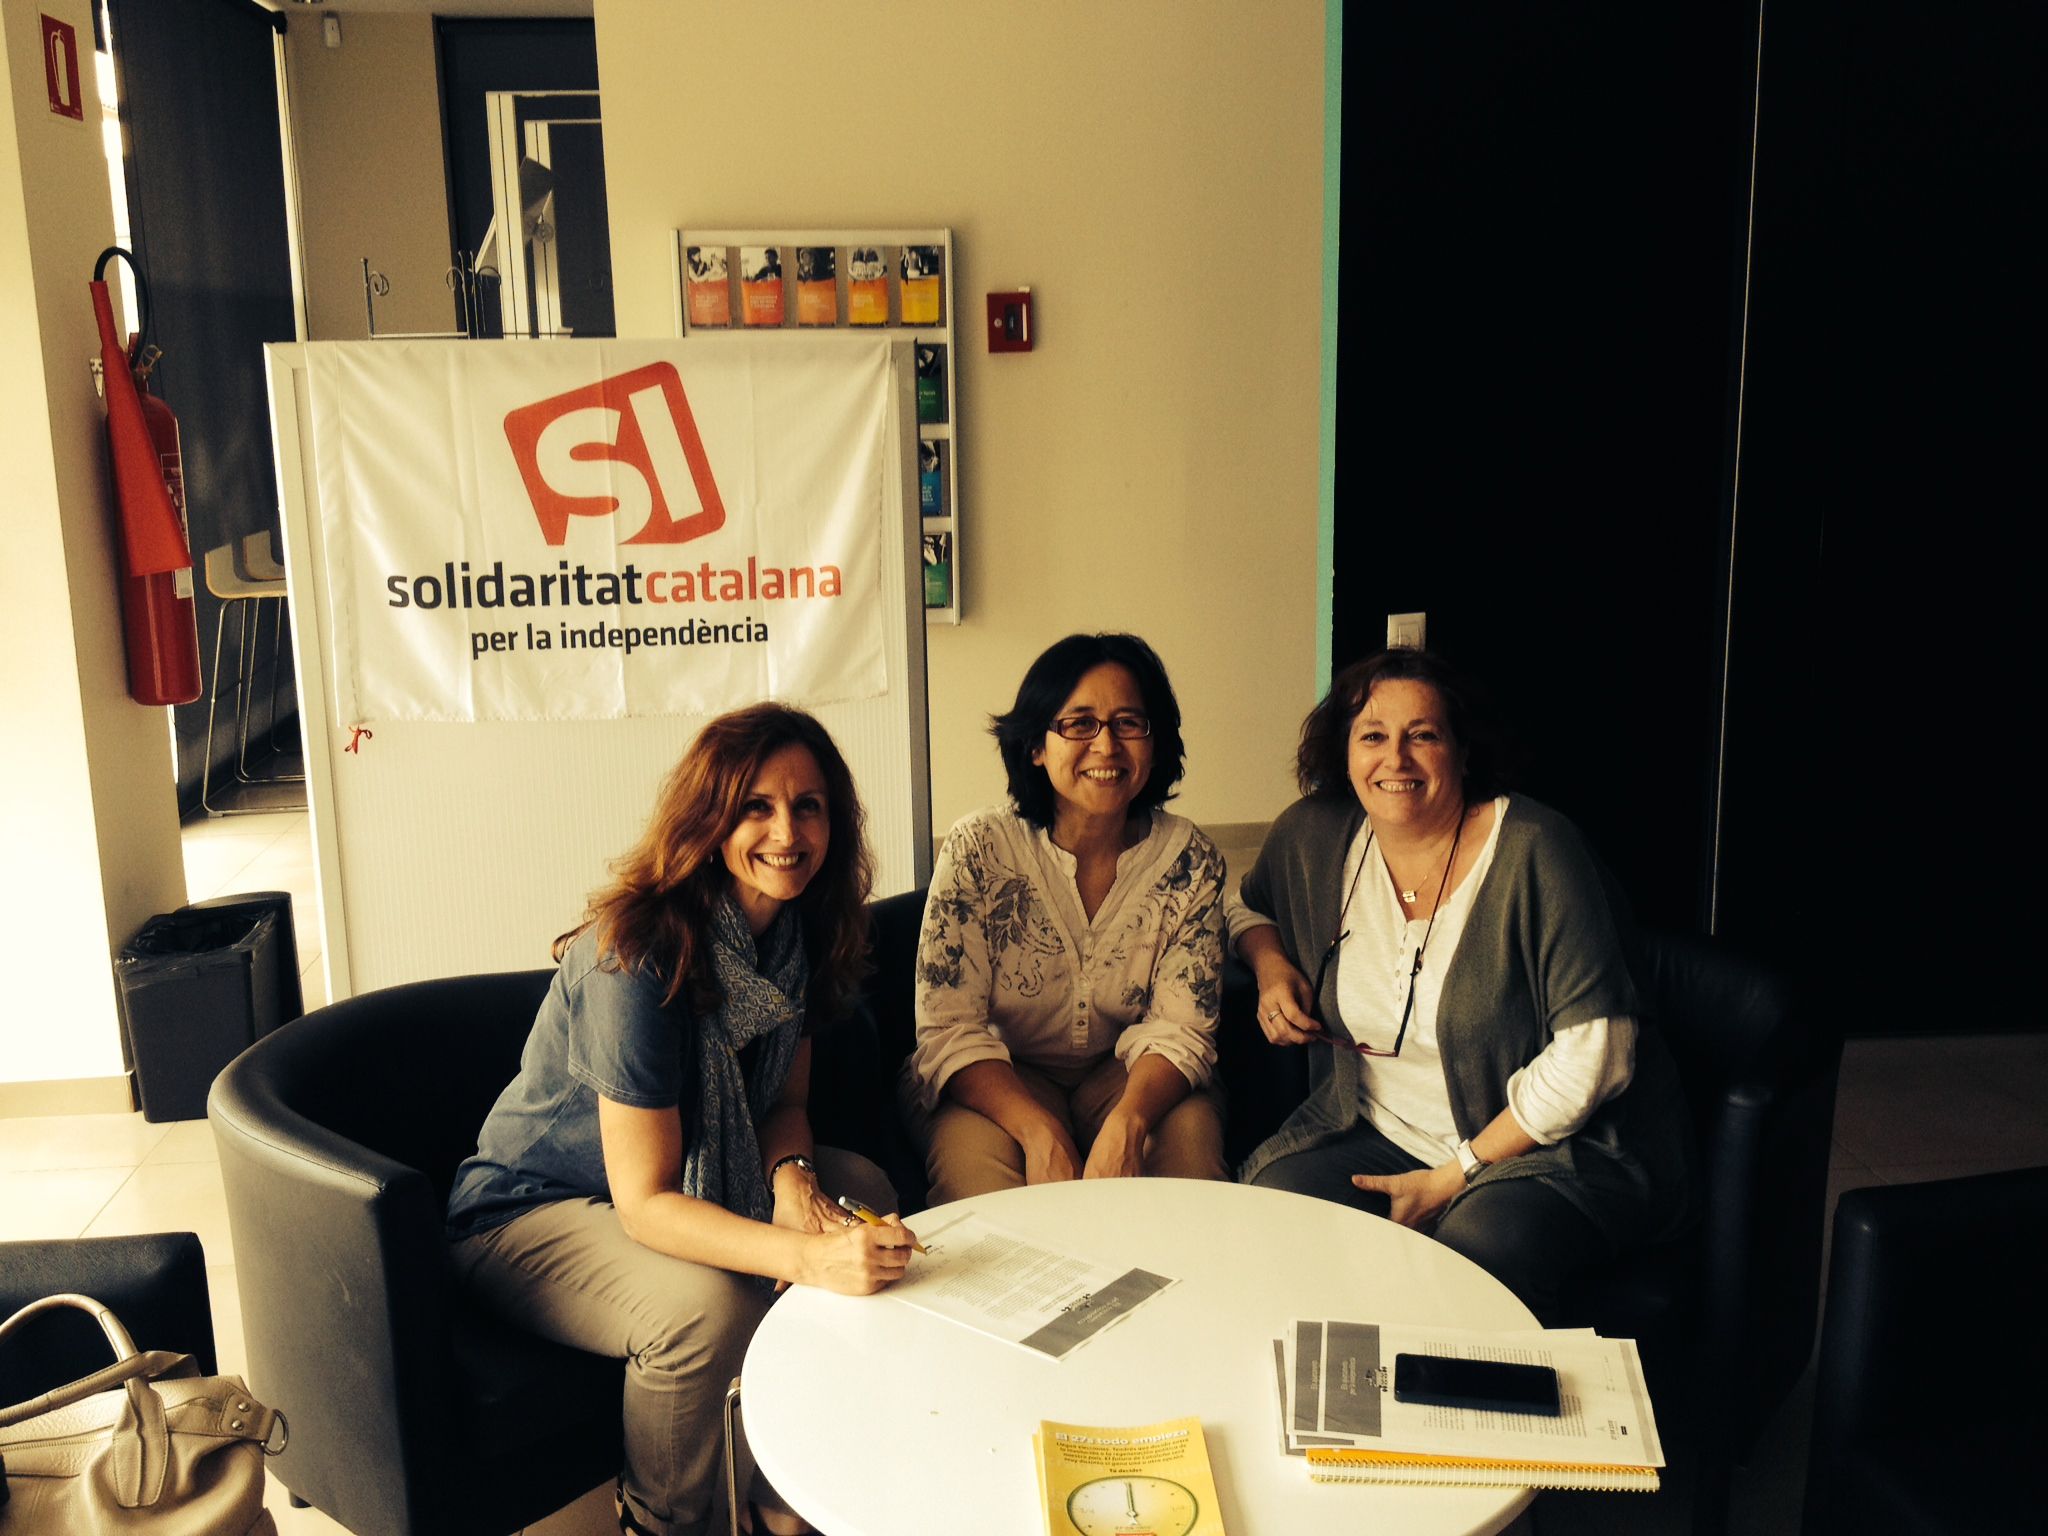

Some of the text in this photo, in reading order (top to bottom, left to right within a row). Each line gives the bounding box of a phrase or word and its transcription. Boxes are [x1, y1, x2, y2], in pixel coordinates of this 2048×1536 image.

[535, 383, 705, 545] SI
[471, 617, 769, 661] per la independència
